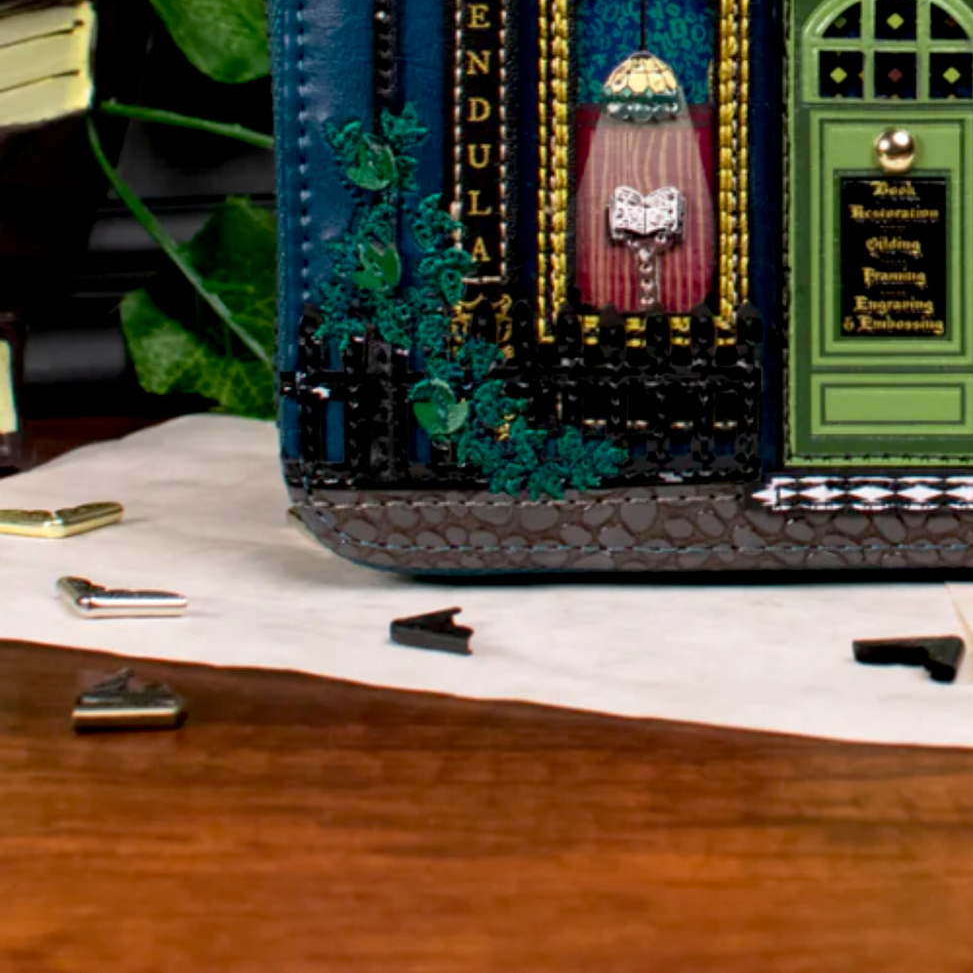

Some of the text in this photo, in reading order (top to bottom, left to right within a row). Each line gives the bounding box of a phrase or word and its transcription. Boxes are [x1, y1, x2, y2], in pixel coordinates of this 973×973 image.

[849, 204, 939, 219] Restoration
[854, 295, 934, 314] Engraving
[858, 315, 944, 334] Embossing
